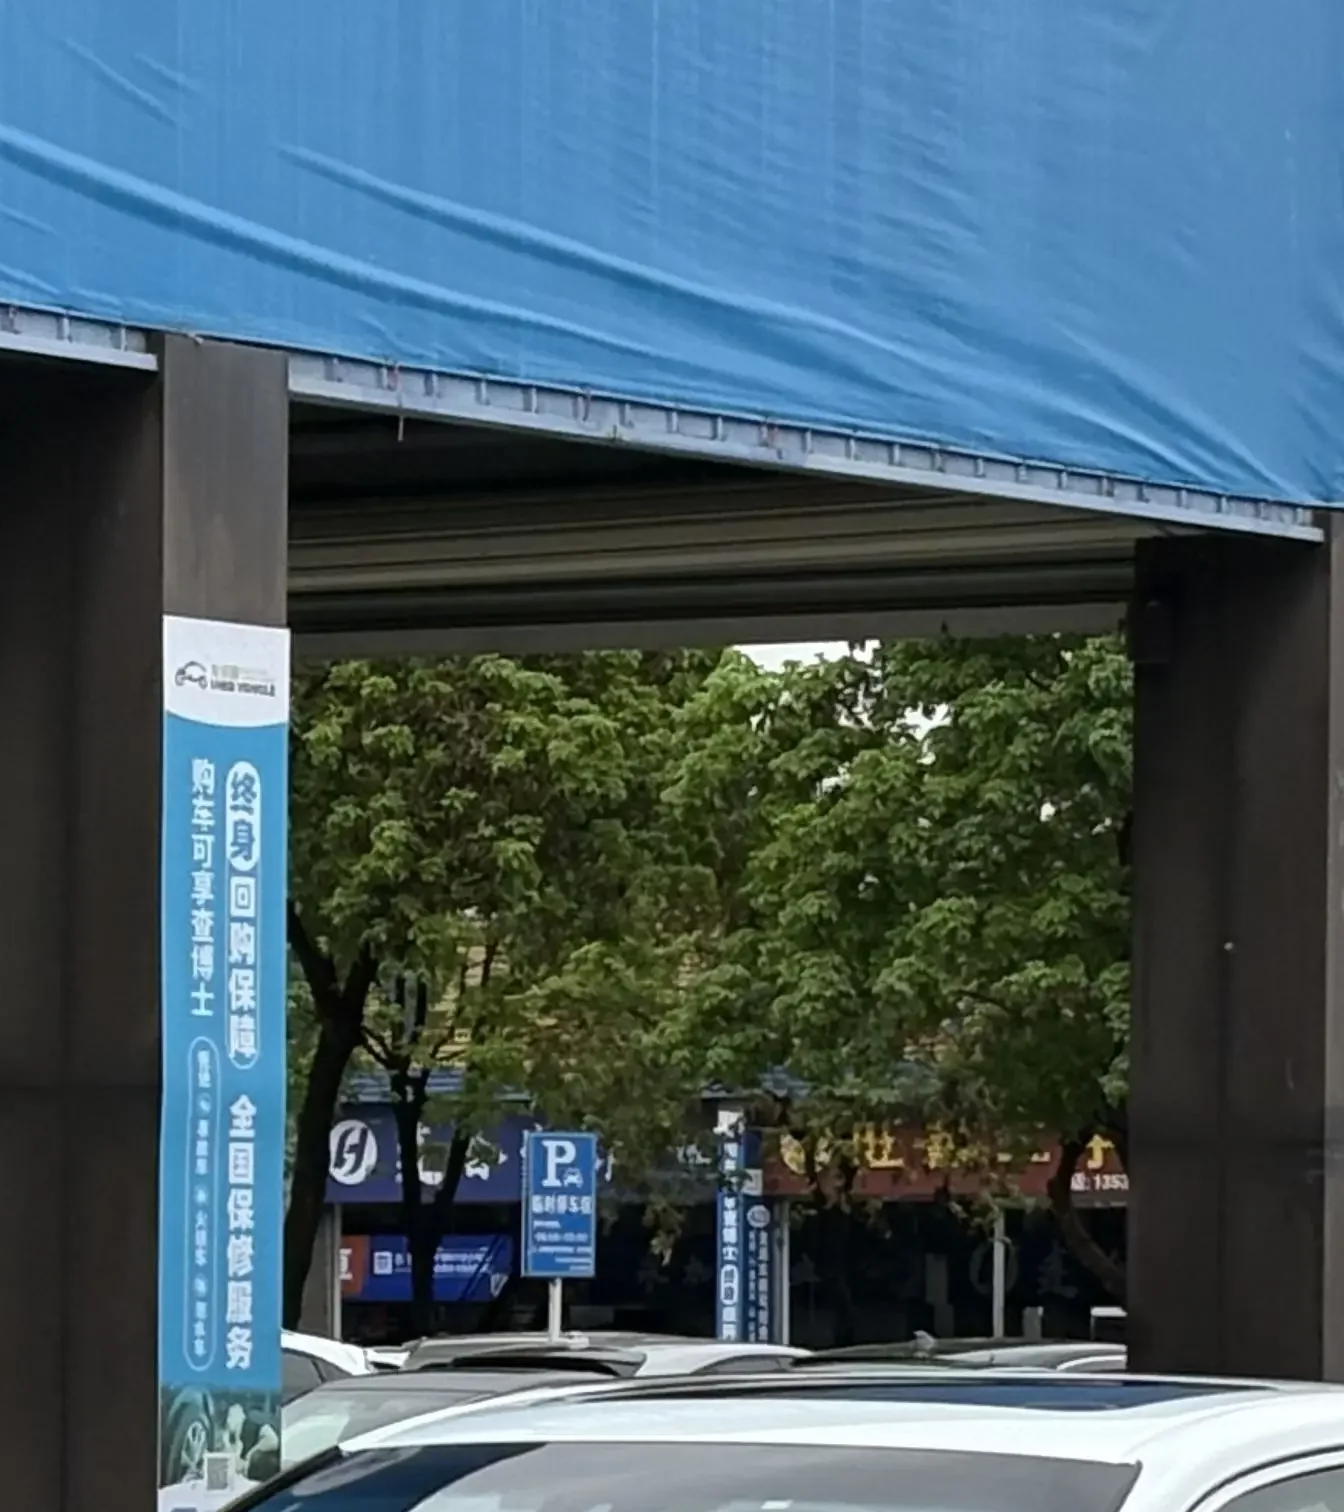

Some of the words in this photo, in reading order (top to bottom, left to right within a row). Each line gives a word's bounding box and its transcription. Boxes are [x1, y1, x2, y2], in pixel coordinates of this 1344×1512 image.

[191, 757, 215, 1016] 购车可享查博士
[225, 1094, 257, 1370] 全国保修服务
[540, 1140, 577, 1187] P
